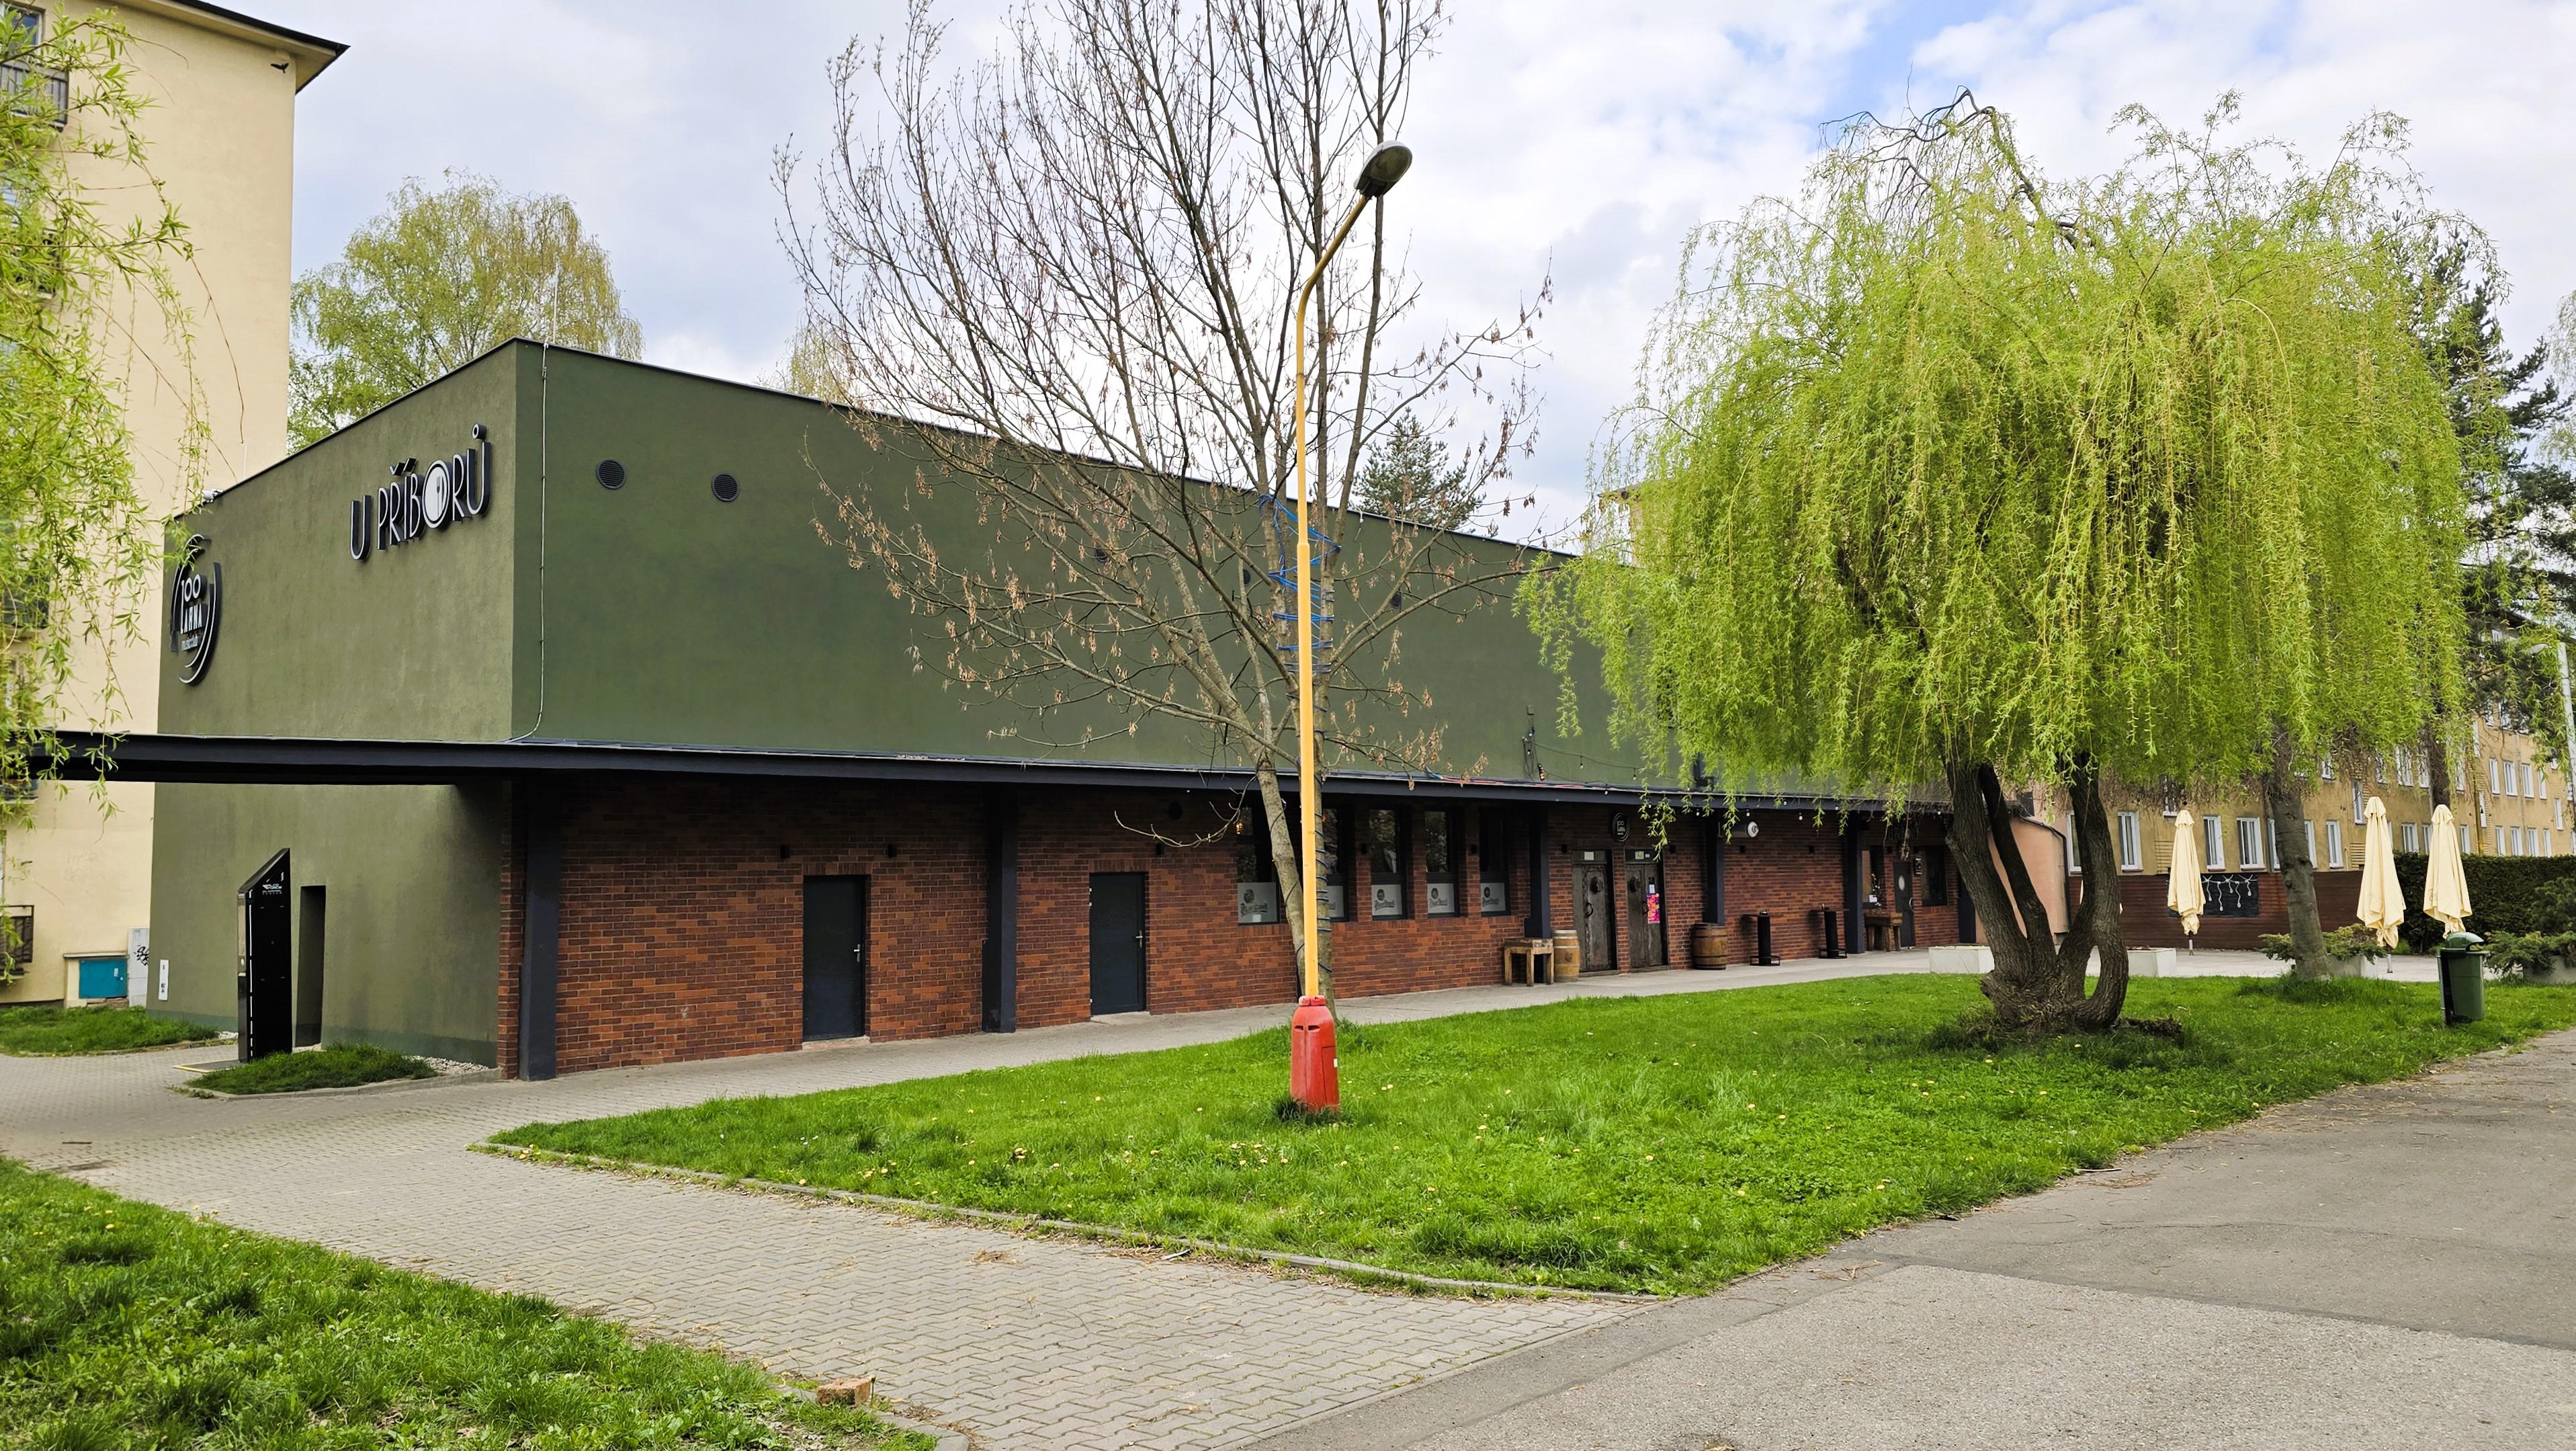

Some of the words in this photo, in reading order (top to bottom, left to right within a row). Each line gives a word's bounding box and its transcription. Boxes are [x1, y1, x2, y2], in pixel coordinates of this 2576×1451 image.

[350, 495, 371, 561] U
[377, 423, 492, 550] PŘÍBORŮ
[181, 574, 204, 603] 100
